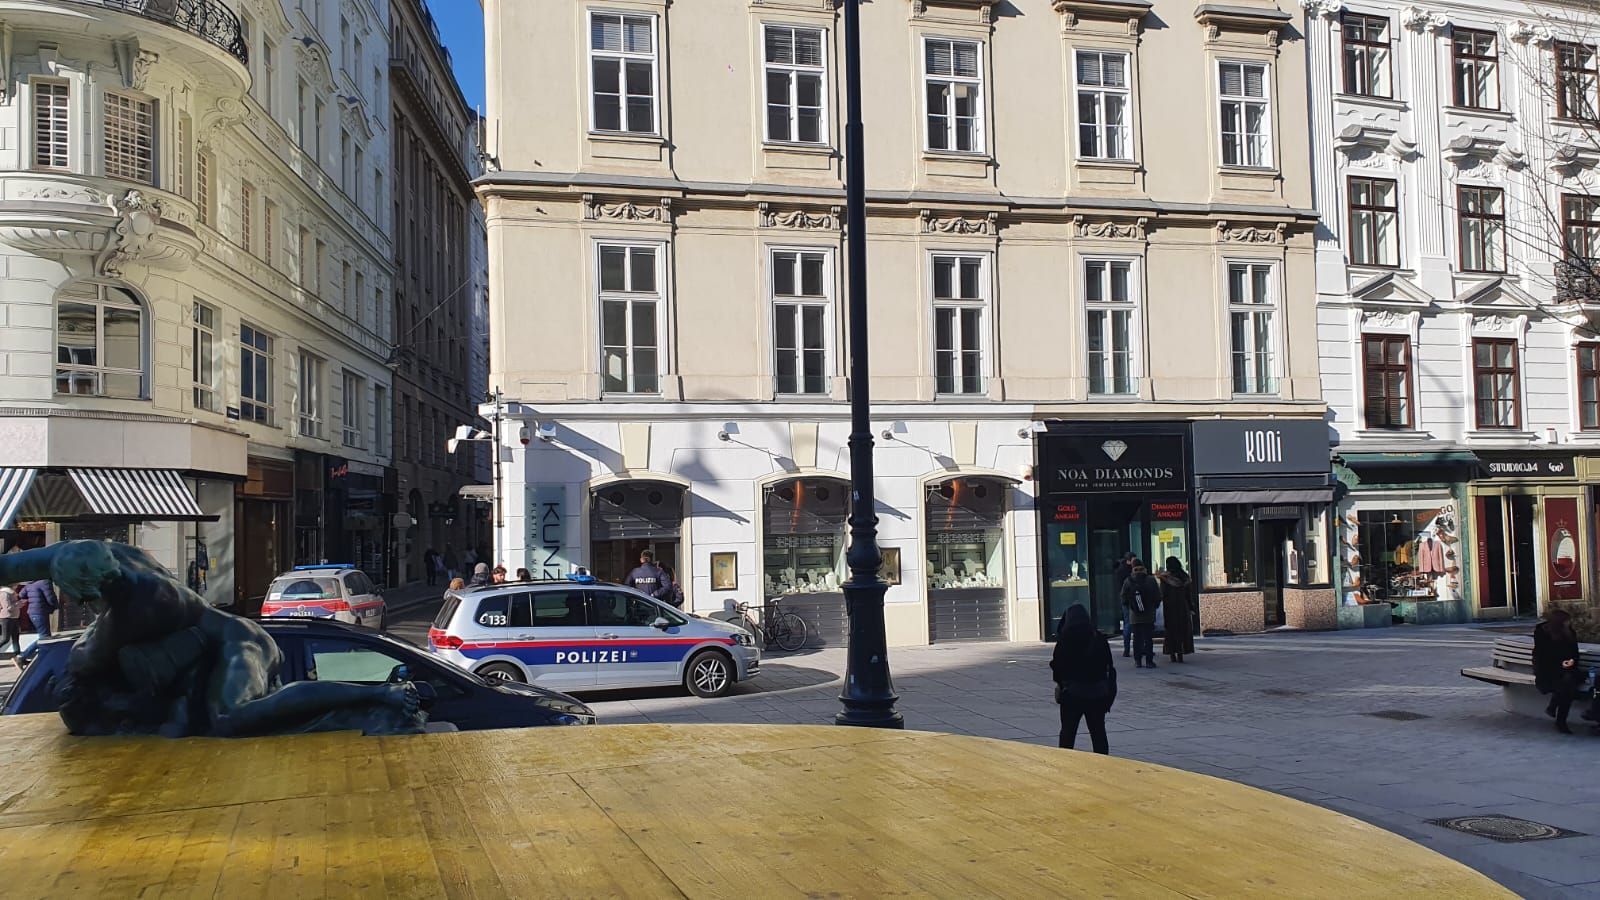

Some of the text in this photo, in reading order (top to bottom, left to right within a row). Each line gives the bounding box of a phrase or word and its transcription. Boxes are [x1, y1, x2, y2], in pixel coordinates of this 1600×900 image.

[1058, 467, 1174, 480] NOA DIAMONDS
[1057, 504, 1077, 512] GOLD
[1151, 503, 1189, 511] DIAMANTEN
[488, 615, 507, 625] 133
[556, 650, 627, 663] POLIZEI
